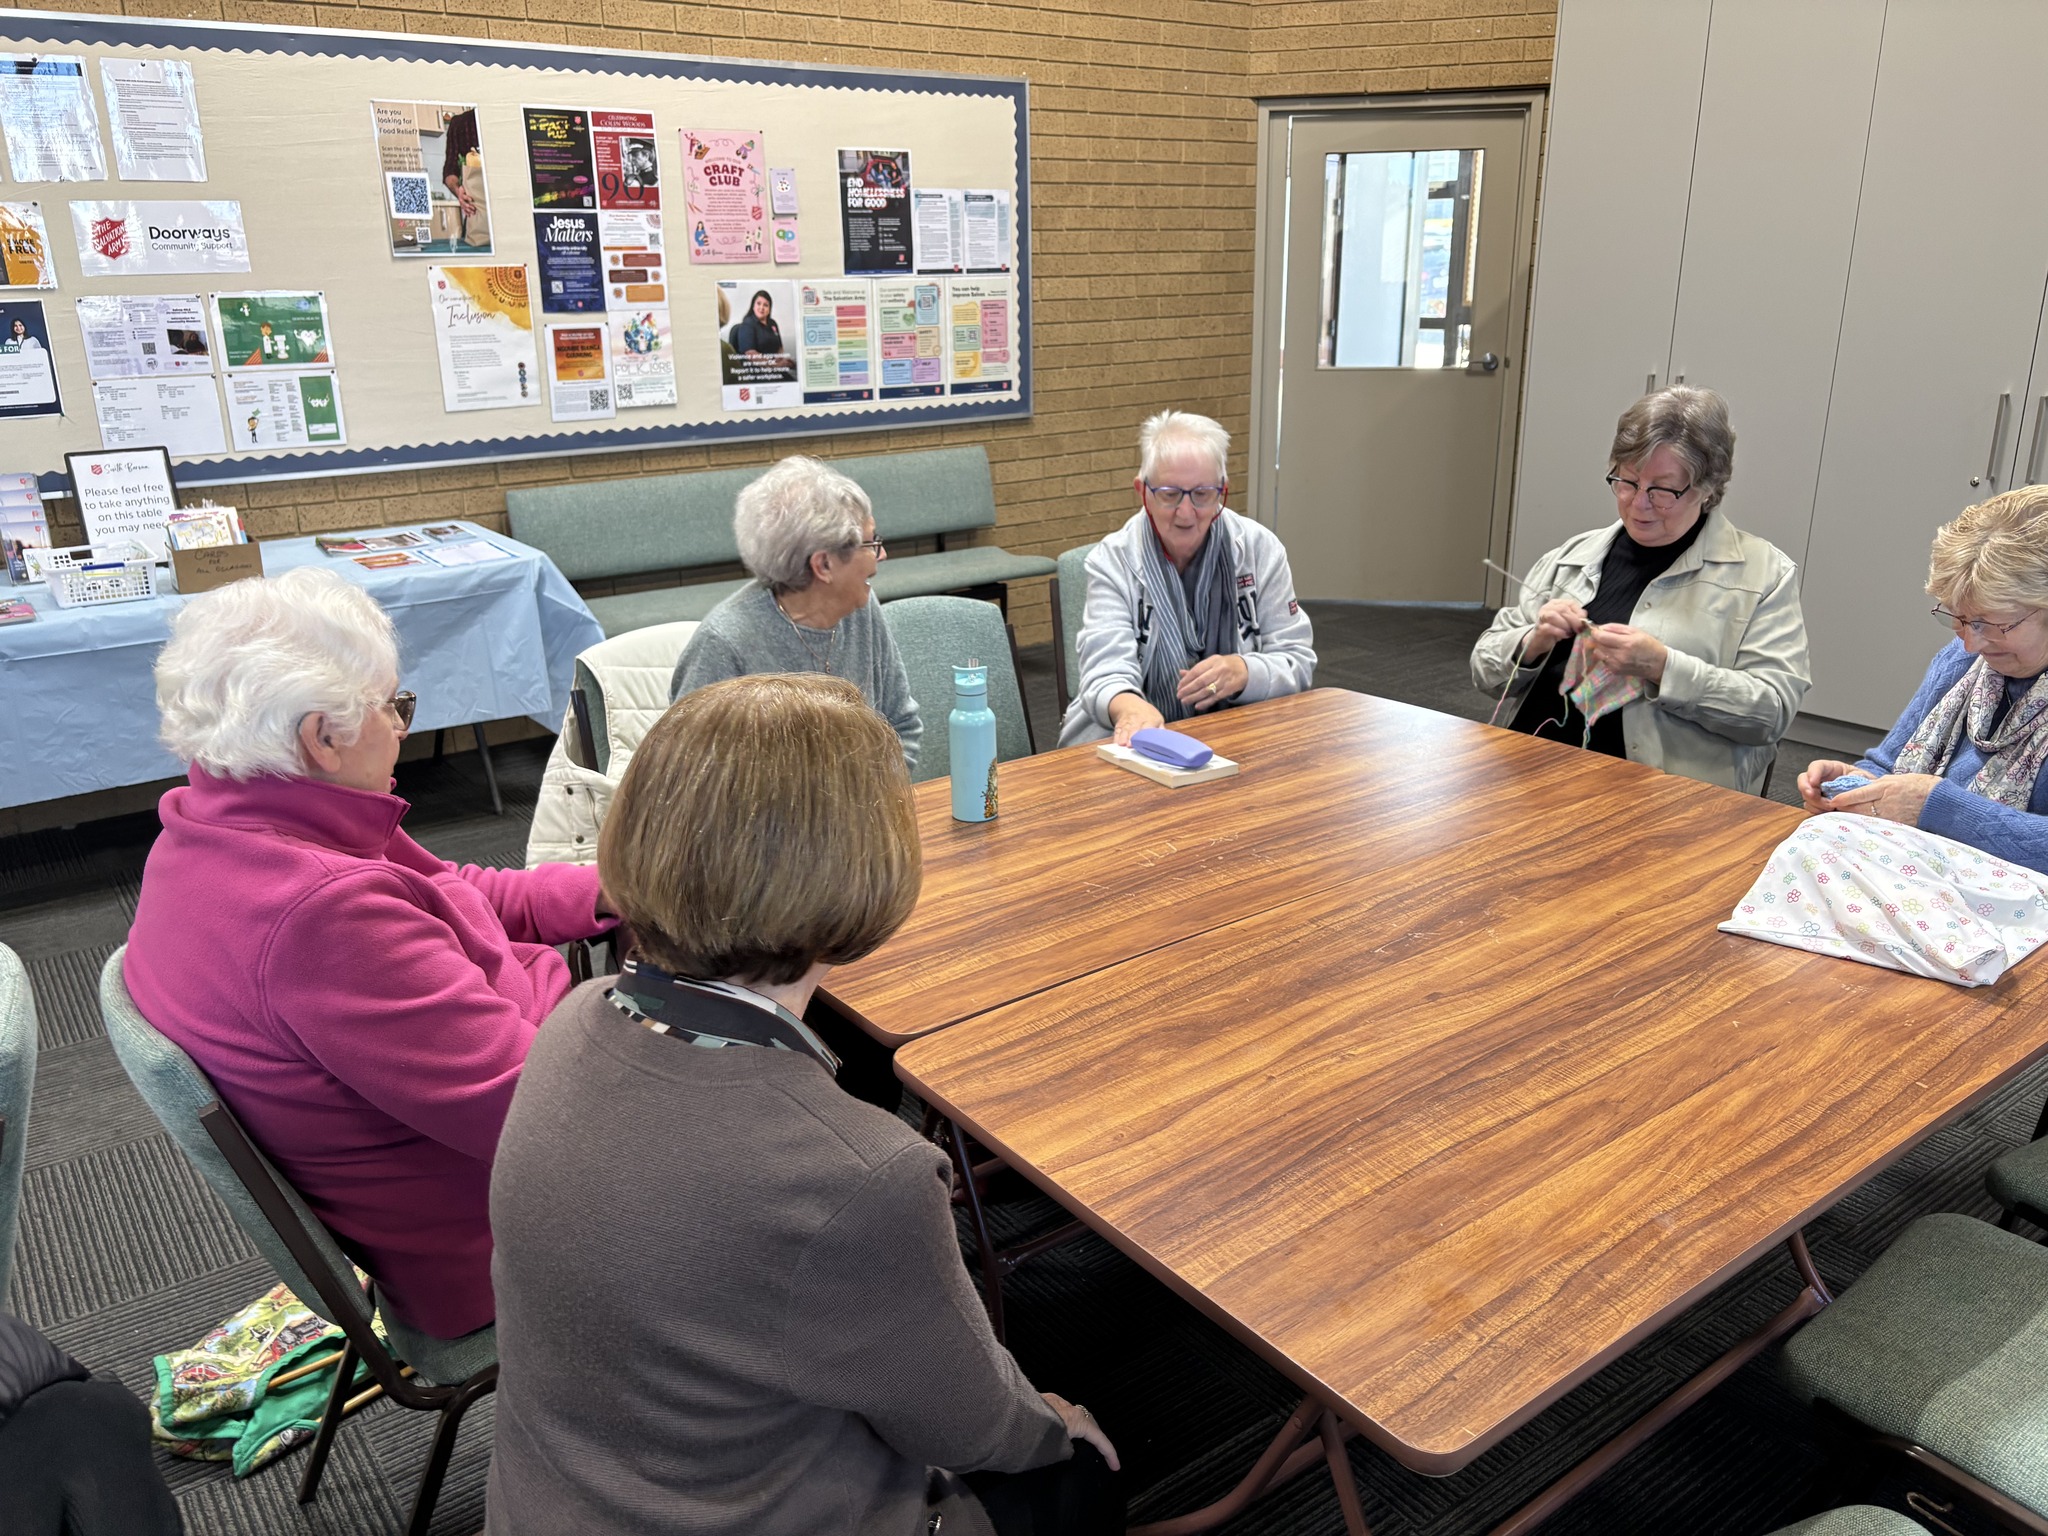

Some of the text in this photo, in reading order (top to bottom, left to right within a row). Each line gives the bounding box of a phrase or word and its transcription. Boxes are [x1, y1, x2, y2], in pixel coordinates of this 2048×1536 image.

[378, 117, 402, 125] looking
[703, 164, 745, 177] CRAFT
[602, 172, 645, 201] 90
[709, 175, 740, 186] CLUB
[847, 177, 864, 188] END
[847, 187, 906, 199] HOMELESSNESS
[847, 197, 887, 208] FOR GOOD
[97, 220, 111, 234] THE
[550, 216, 585, 229] Jesus
[95, 222, 126, 250] SALVATION
[149, 226, 230, 242] Doorways
[544, 227, 593, 242] Matters
[108, 237, 125, 255] ARMY
[201, 242, 232, 251] Support
[446, 303, 496, 328] Inclusion
[4, 345, 19, 353] FOR
[84, 483, 164, 497] Please feel free
[84, 495, 170, 510] to take anything
[114, 510, 134, 520] this
[136, 508, 163, 519] table
[95, 526, 115, 537] you
[118, 524, 140, 533] may
